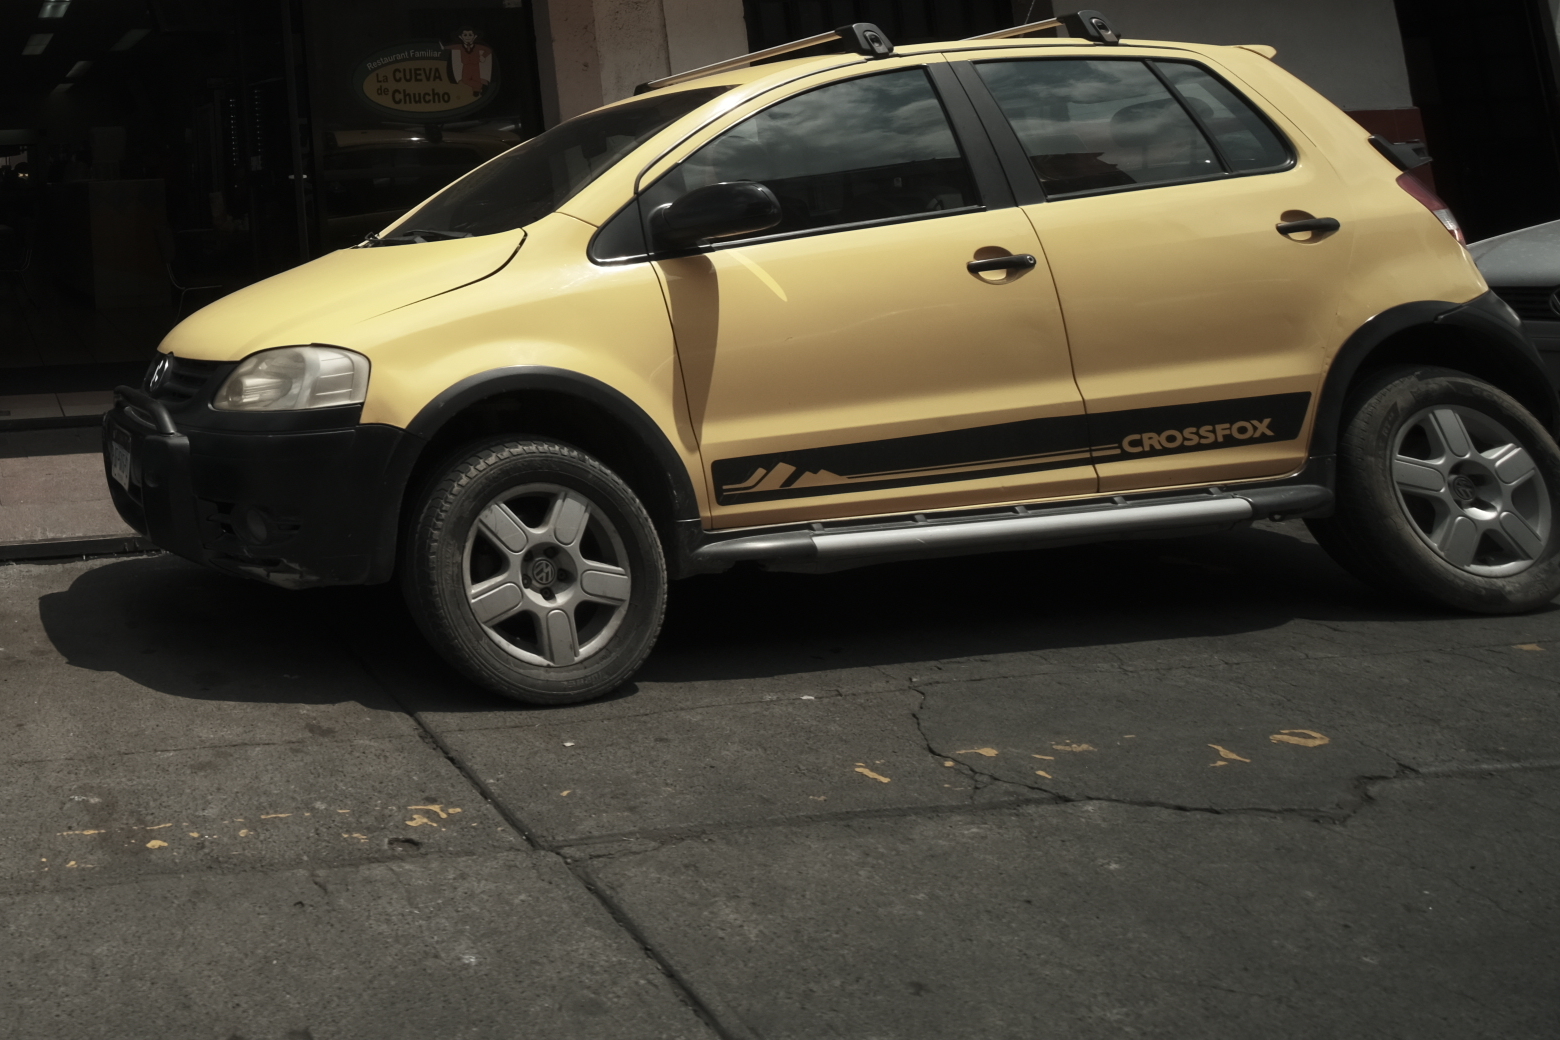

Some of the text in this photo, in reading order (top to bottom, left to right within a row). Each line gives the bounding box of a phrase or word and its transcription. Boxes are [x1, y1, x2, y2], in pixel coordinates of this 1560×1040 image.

[366, 49, 442, 72] Restaurant Familiar
[376, 67, 443, 83] La CUEVA
[376, 85, 451, 105] de Chucho
[1122, 418, 1275, 453] CROSSFOX
